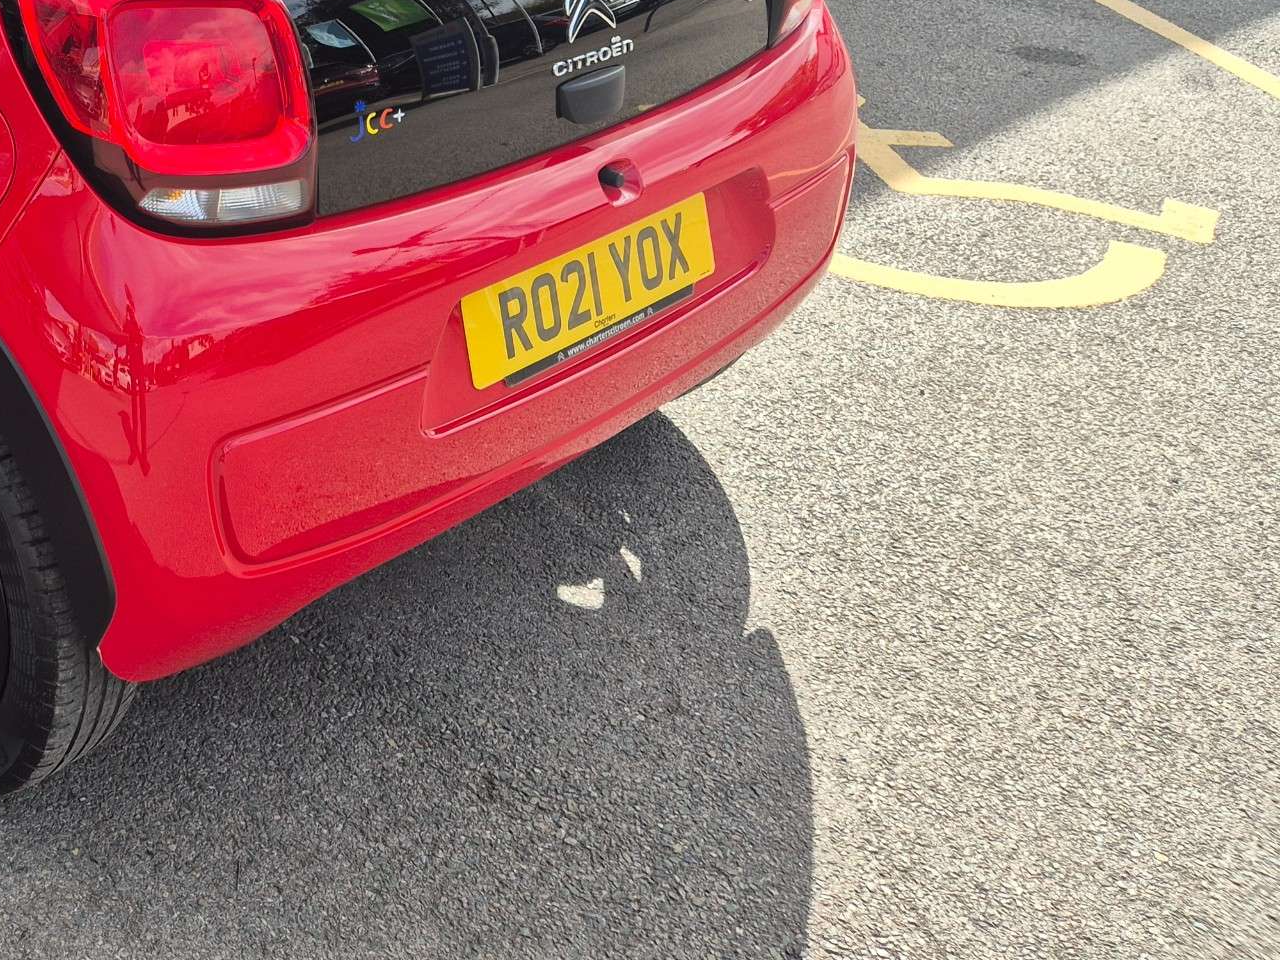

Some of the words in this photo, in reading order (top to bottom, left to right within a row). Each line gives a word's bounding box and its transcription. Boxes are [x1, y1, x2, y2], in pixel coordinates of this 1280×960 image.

[498, 251, 603, 360] RO21
[608, 212, 690, 302] YOX
[567, 312, 645, 356] www.charterscitroen.com
